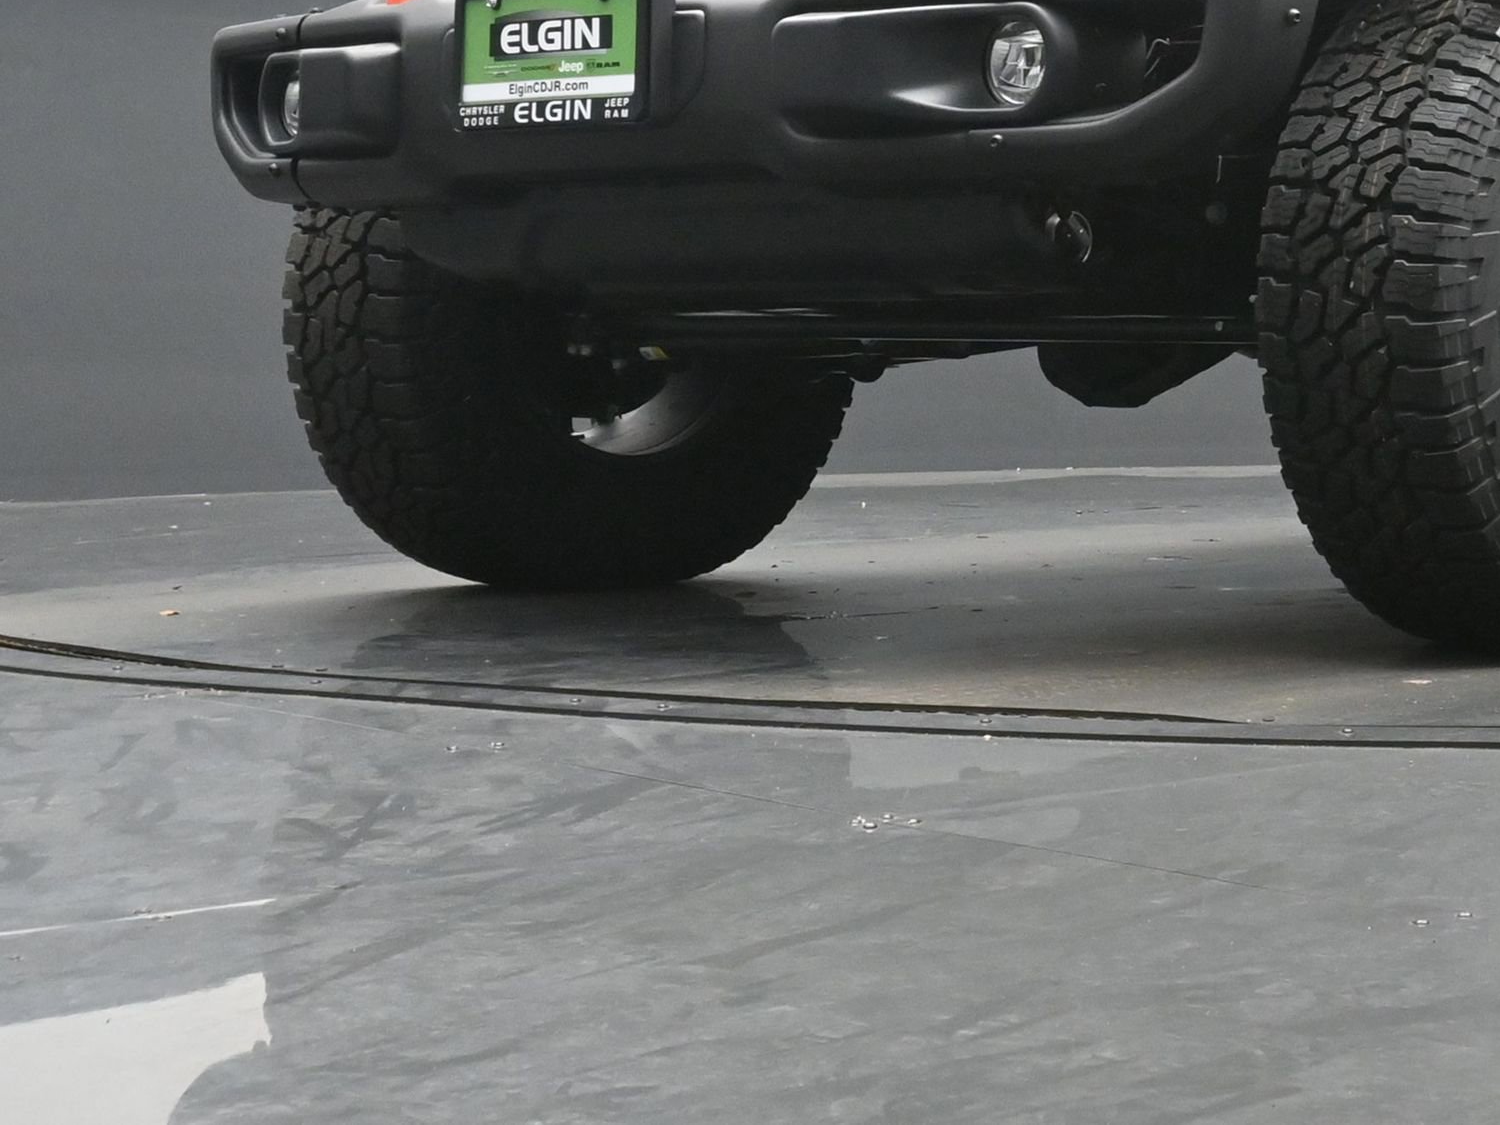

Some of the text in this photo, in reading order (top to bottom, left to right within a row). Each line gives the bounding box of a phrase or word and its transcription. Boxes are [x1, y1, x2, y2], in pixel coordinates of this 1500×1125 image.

[500, 17, 600, 55] ELGIN
[558, 60, 584, 74] Jeep
[509, 80, 589, 97] ElginCDJR.com
[604, 98, 630, 108] JEEP
[460, 105, 505, 117] CHRYSLER
[514, 99, 592, 123] ELGIN
[604, 109, 630, 119] RAM
[464, 116, 499, 127] DODGE
